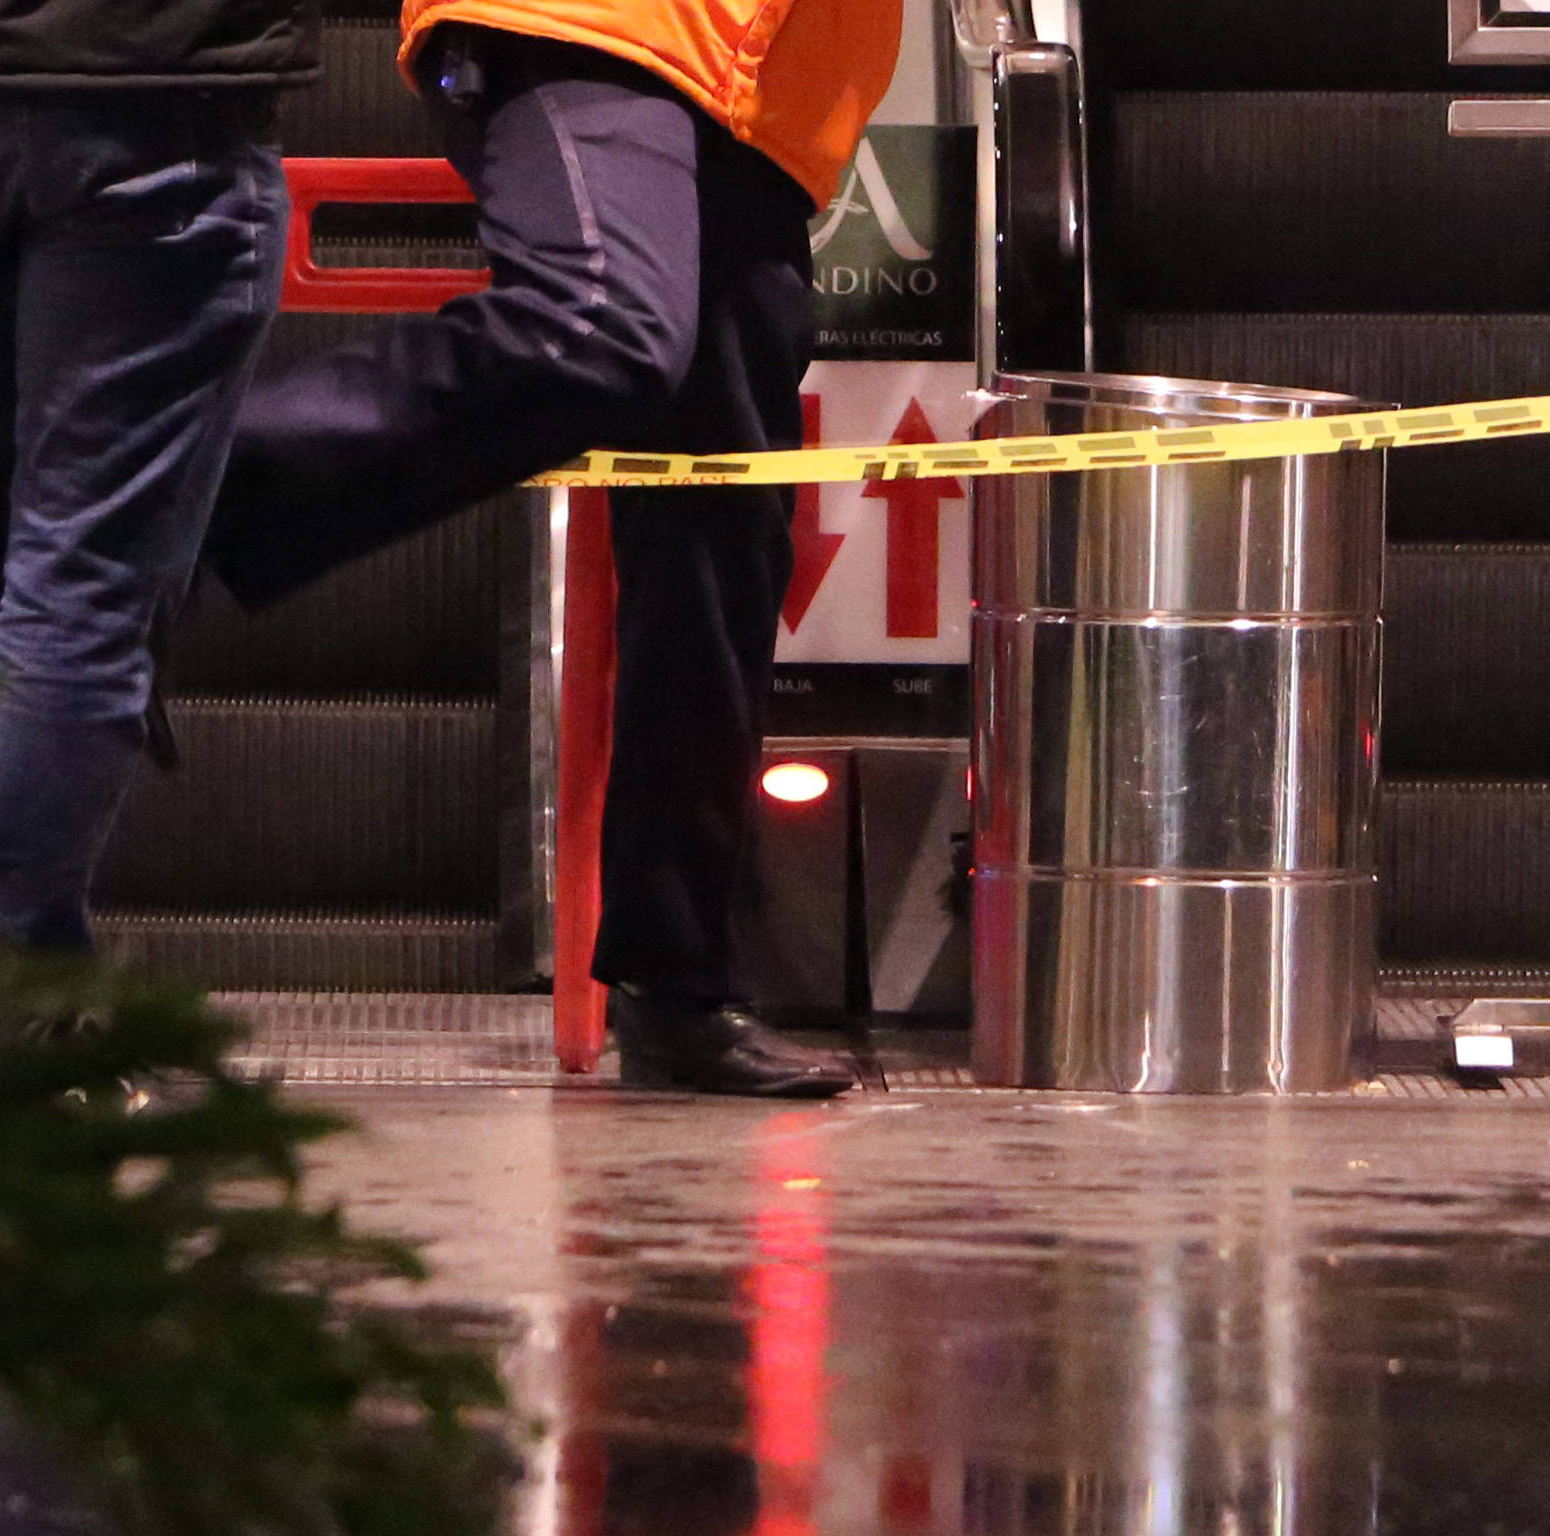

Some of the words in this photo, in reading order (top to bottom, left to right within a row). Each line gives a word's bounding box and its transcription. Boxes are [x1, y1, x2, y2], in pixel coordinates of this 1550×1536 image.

[812, 266, 938, 295] NDINO
[773, 678, 813, 692] BAJA
[892, 678, 932, 694] SUBE
